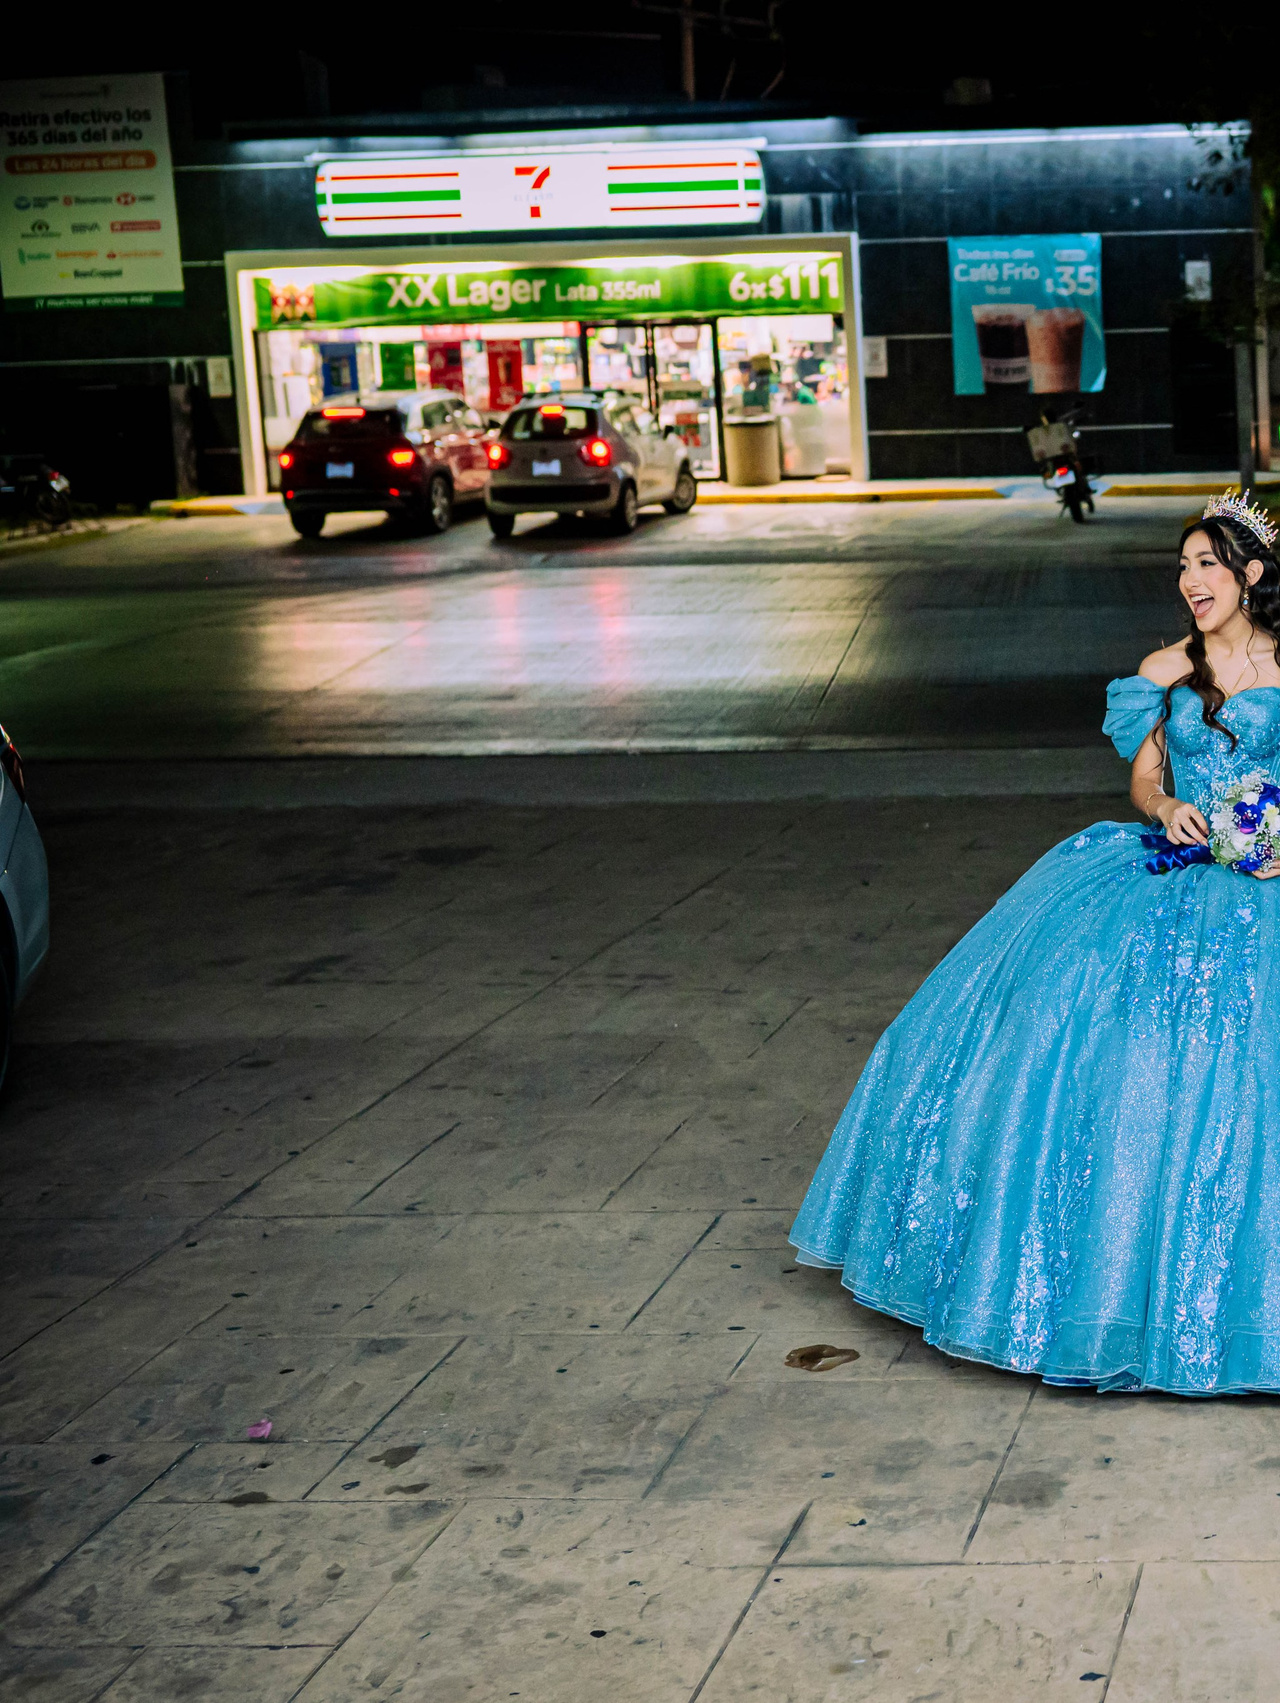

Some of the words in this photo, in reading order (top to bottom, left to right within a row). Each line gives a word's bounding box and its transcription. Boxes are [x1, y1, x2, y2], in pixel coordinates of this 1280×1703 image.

[0, 111, 50, 127] Retira
[54, 109, 123, 125] efectivo
[126, 107, 152, 122] los
[7, 130, 38, 146] 365
[81, 127, 107, 143] del
[111, 126, 143, 142] año
[514, 166, 551, 218] 7
[954, 262, 999, 282] Café
[1002, 262, 1040, 282] Frío
[386, 274, 441, 309] XX
[446, 274, 547, 312] Lager
[555, 282, 598, 302] Lata
[601, 279, 661, 301] 355ml
